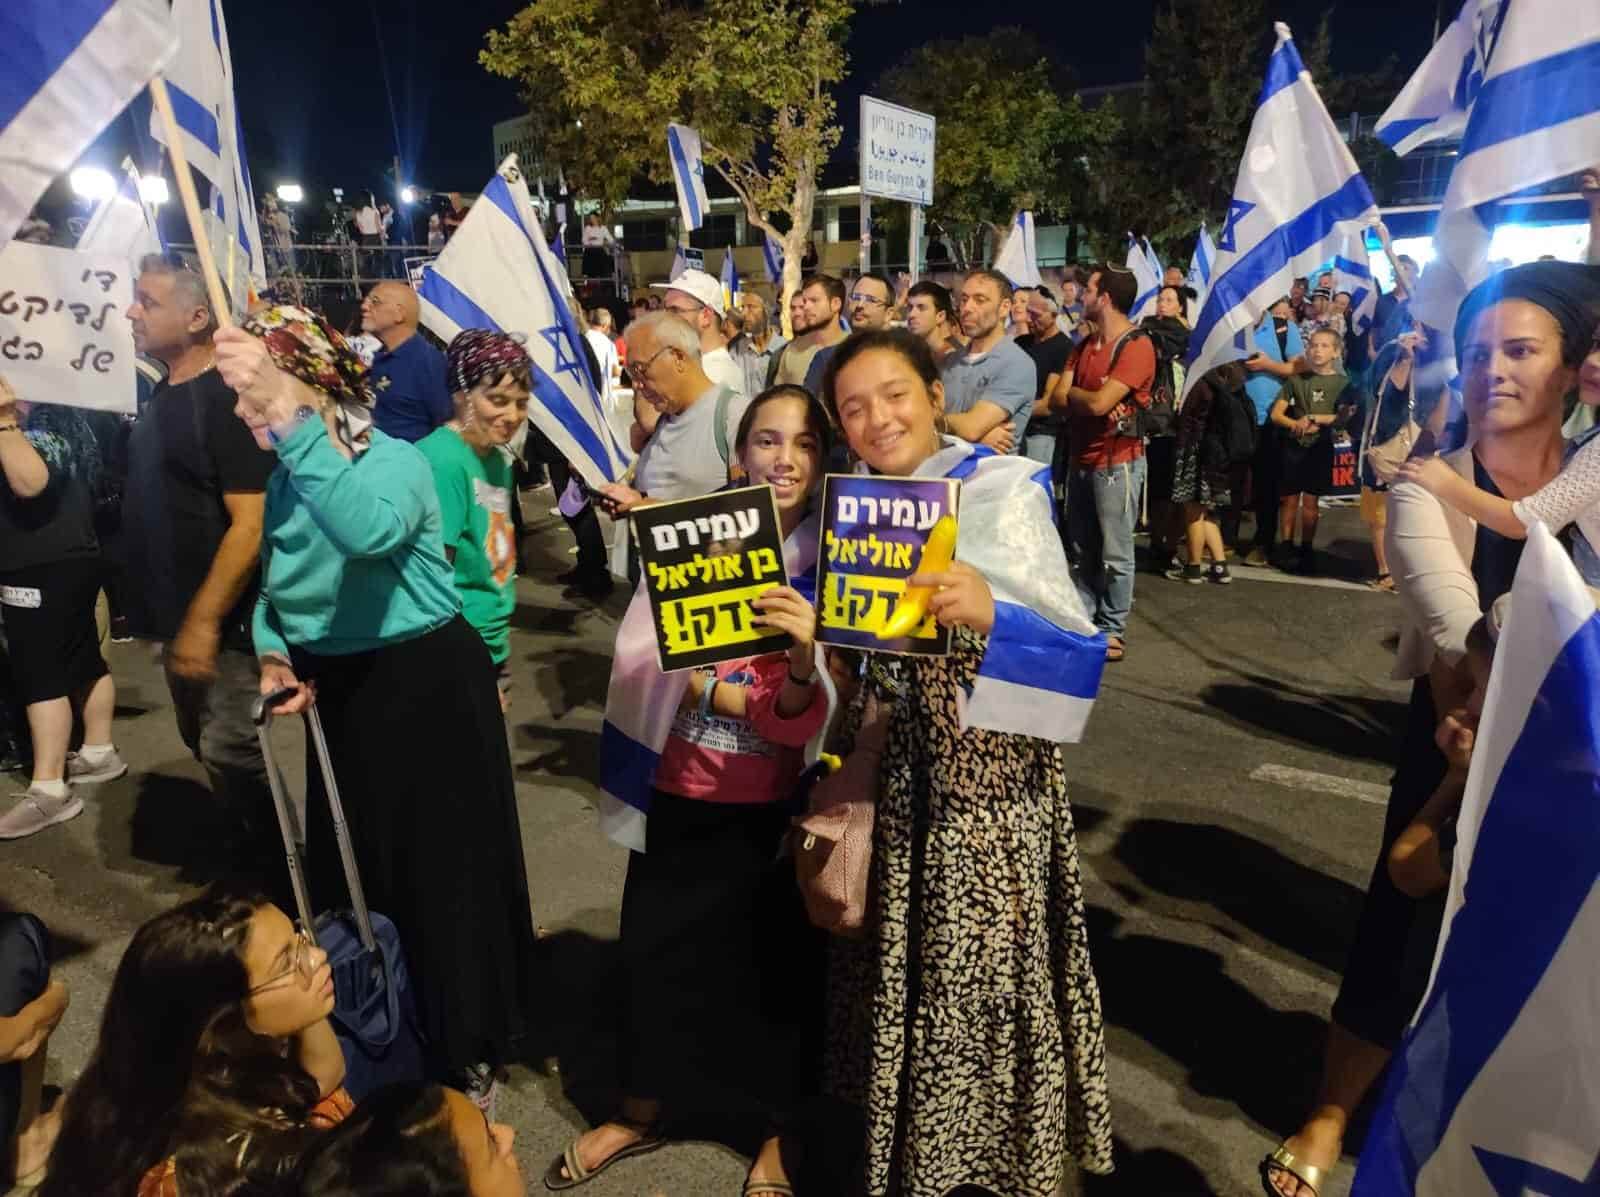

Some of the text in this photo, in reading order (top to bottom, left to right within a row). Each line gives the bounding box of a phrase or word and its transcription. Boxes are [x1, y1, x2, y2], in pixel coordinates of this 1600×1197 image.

[81, 268, 117, 292] די
[69, 342, 115, 373] של
[650, 508, 761, 552] עמירם
[837, 495, 941, 531] עמירם
[647, 547, 780, 592] בן אוליאל
[825, 528, 914, 570] אוליאל
[834, 575, 926, 627] דק!
